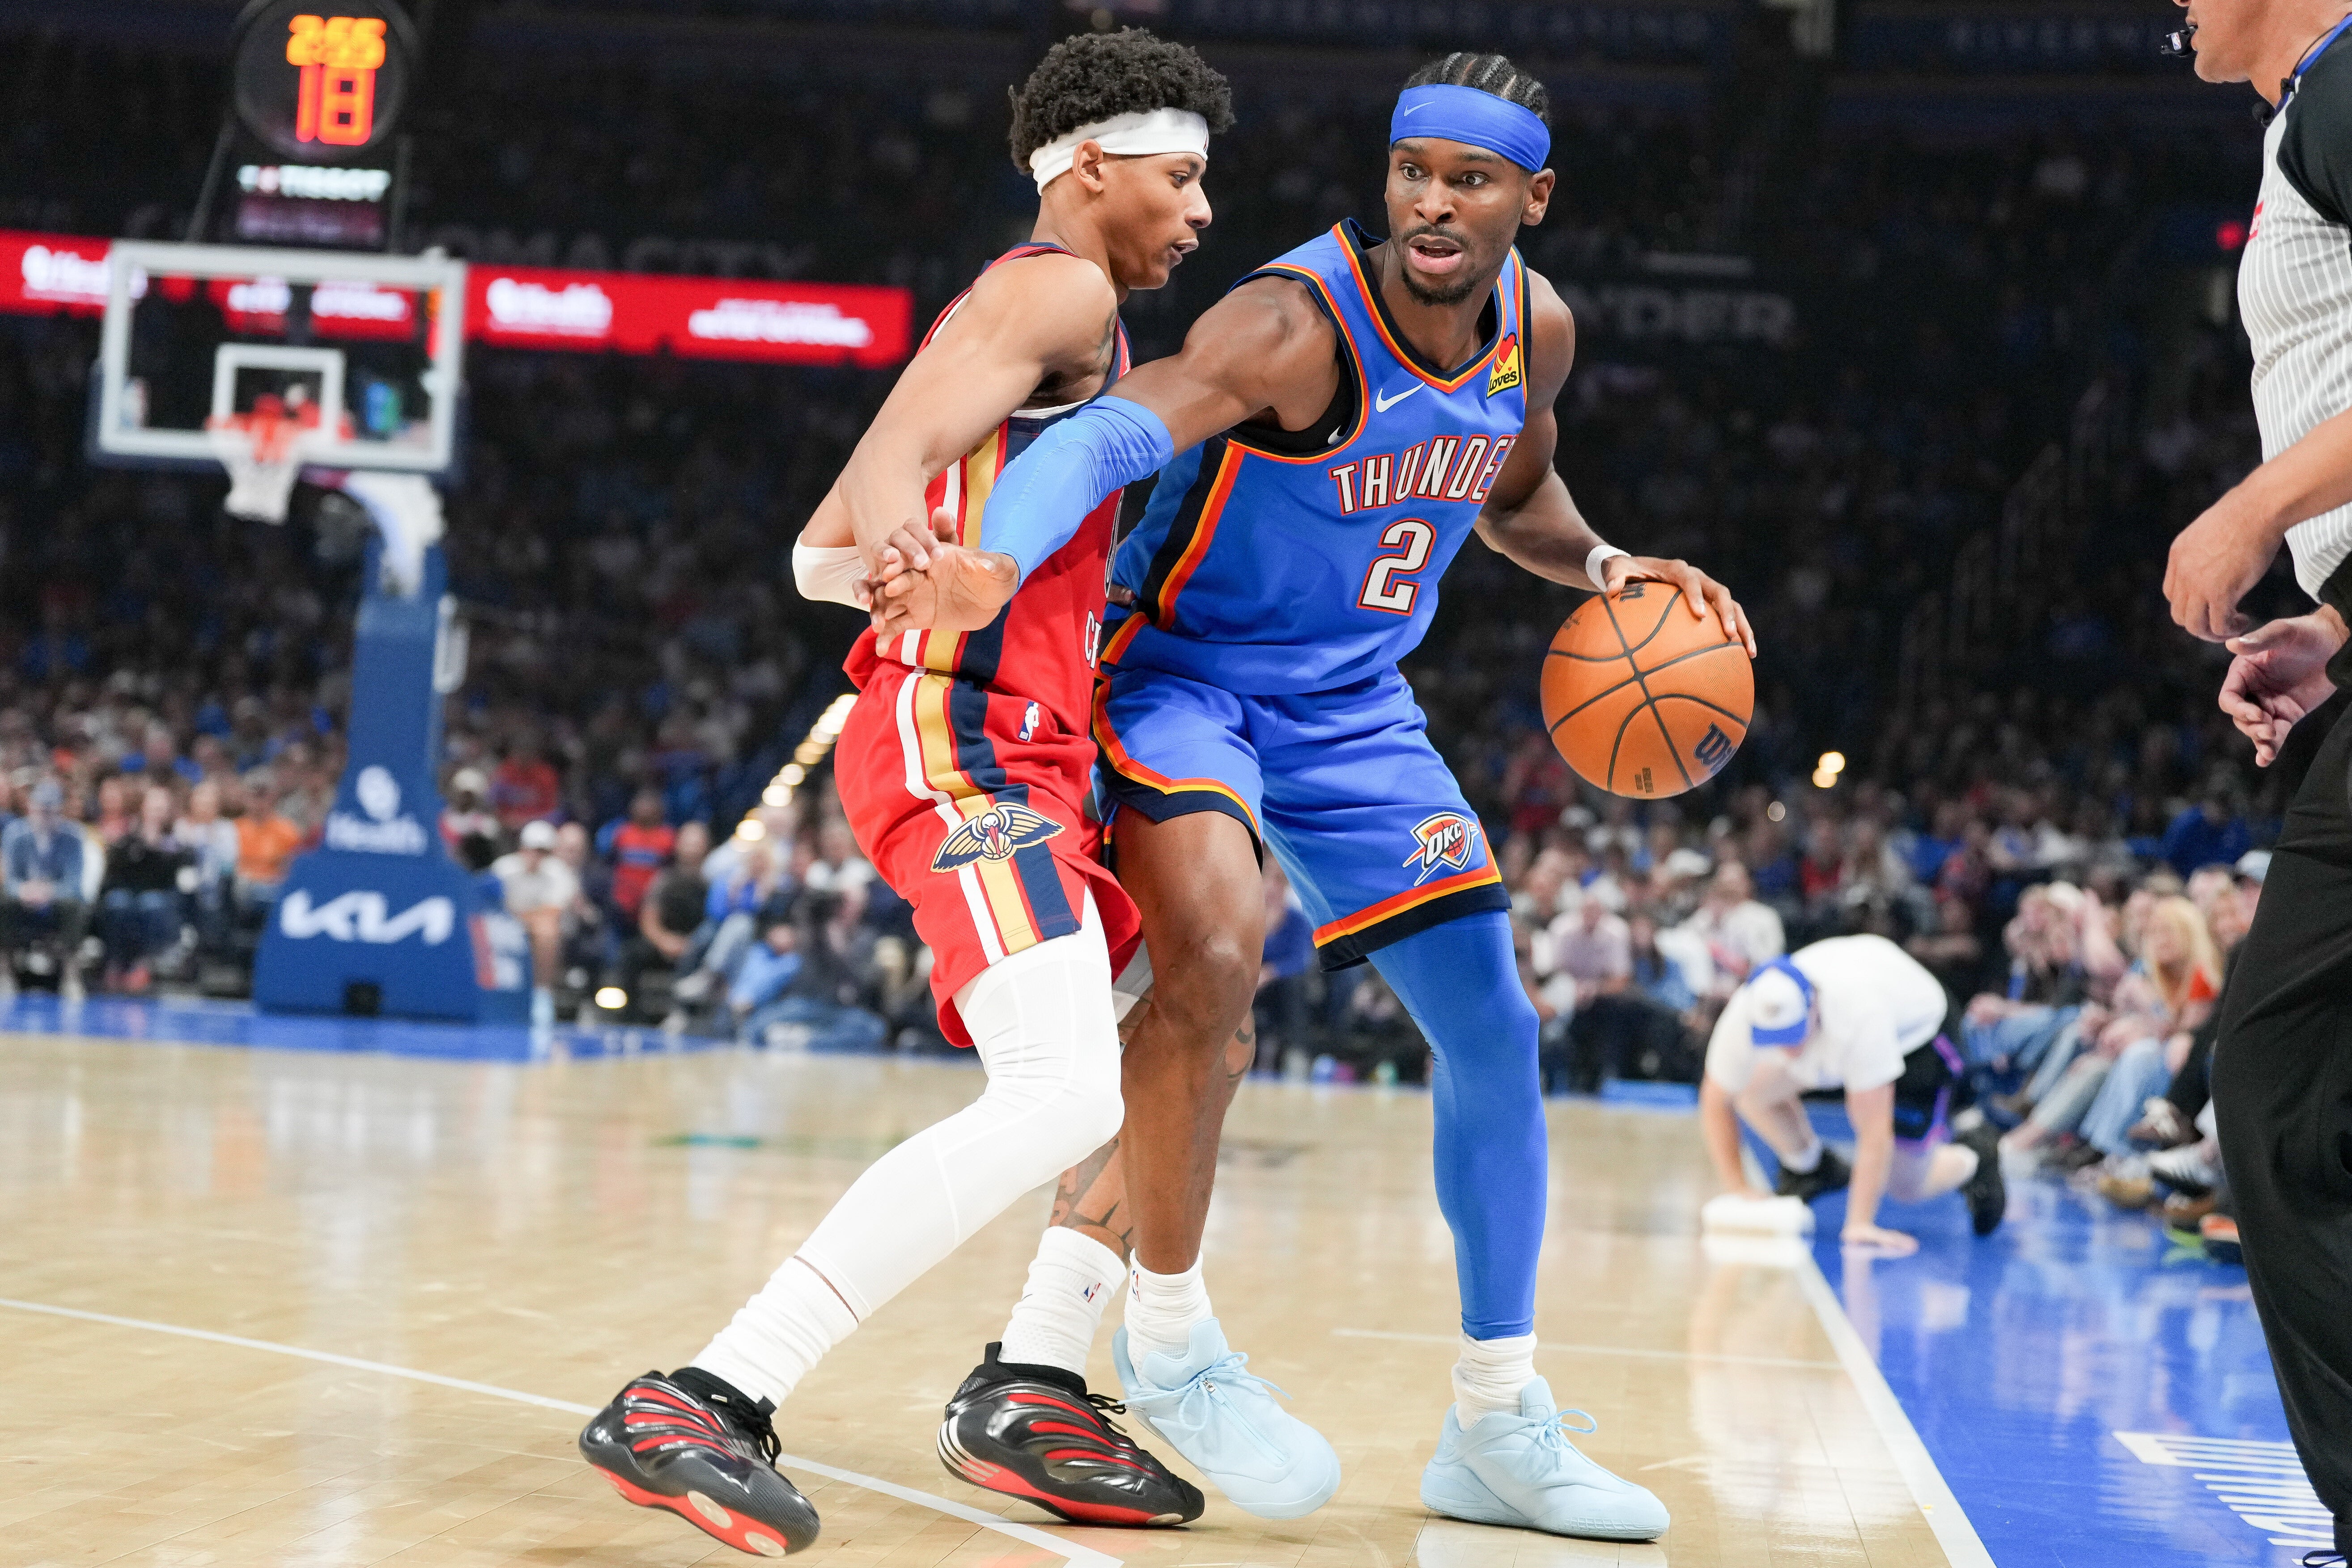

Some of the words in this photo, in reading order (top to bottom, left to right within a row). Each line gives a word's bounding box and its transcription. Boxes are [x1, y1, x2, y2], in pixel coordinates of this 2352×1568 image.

[296, 65, 376, 146] 18
[1356, 518, 1437, 616] 2
[1424, 822, 1462, 868] OKC
[280, 889, 454, 945] KIA
